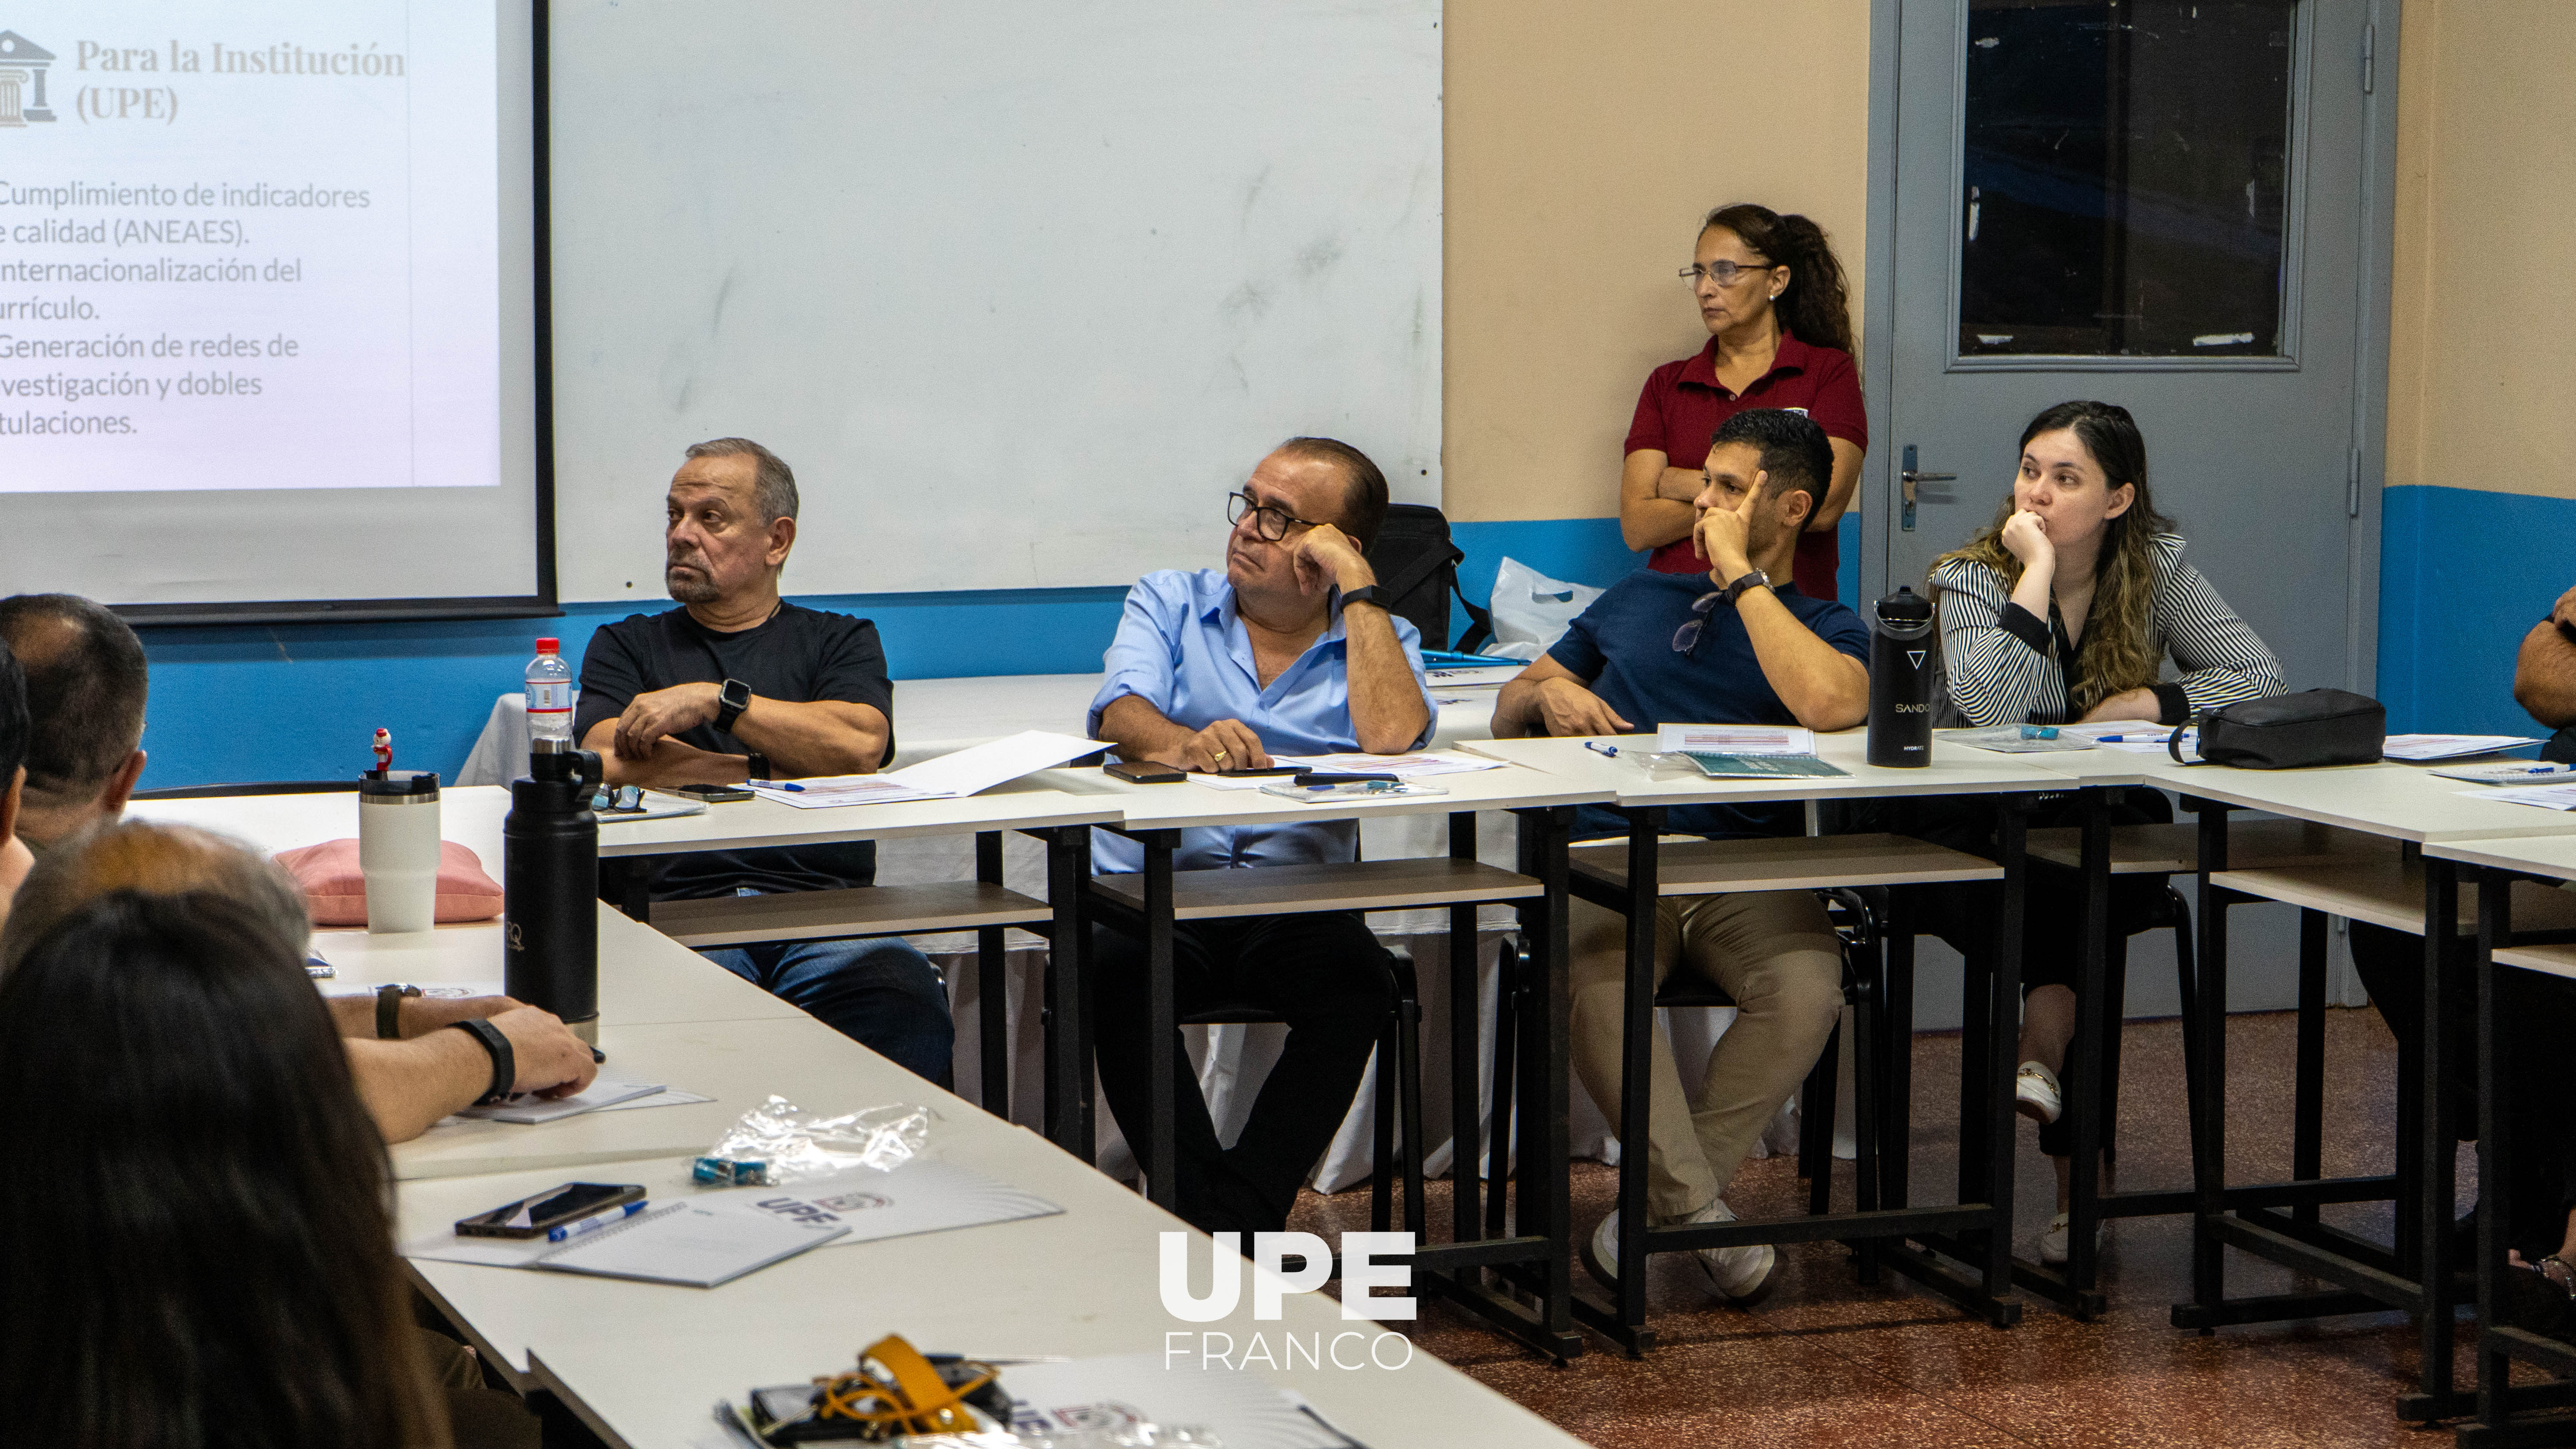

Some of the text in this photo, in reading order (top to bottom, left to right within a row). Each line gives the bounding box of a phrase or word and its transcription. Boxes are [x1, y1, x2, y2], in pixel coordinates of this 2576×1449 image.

[77, 39, 405, 77] Para la Institución
[76, 86, 179, 125] (UPE)
[183, 183, 216, 207] de
[222, 182, 371, 208] indicadores
[13, 218, 106, 244] calidad
[114, 219, 249, 247] (ANEAES).
[263, 257, 302, 282] del
[0, 295, 100, 320] rrículo.
[151, 332, 183, 358] de
[192, 333, 262, 358] redes
[267, 333, 299, 358] de
[156, 378, 171, 402] y
[177, 371, 263, 396] dobles
